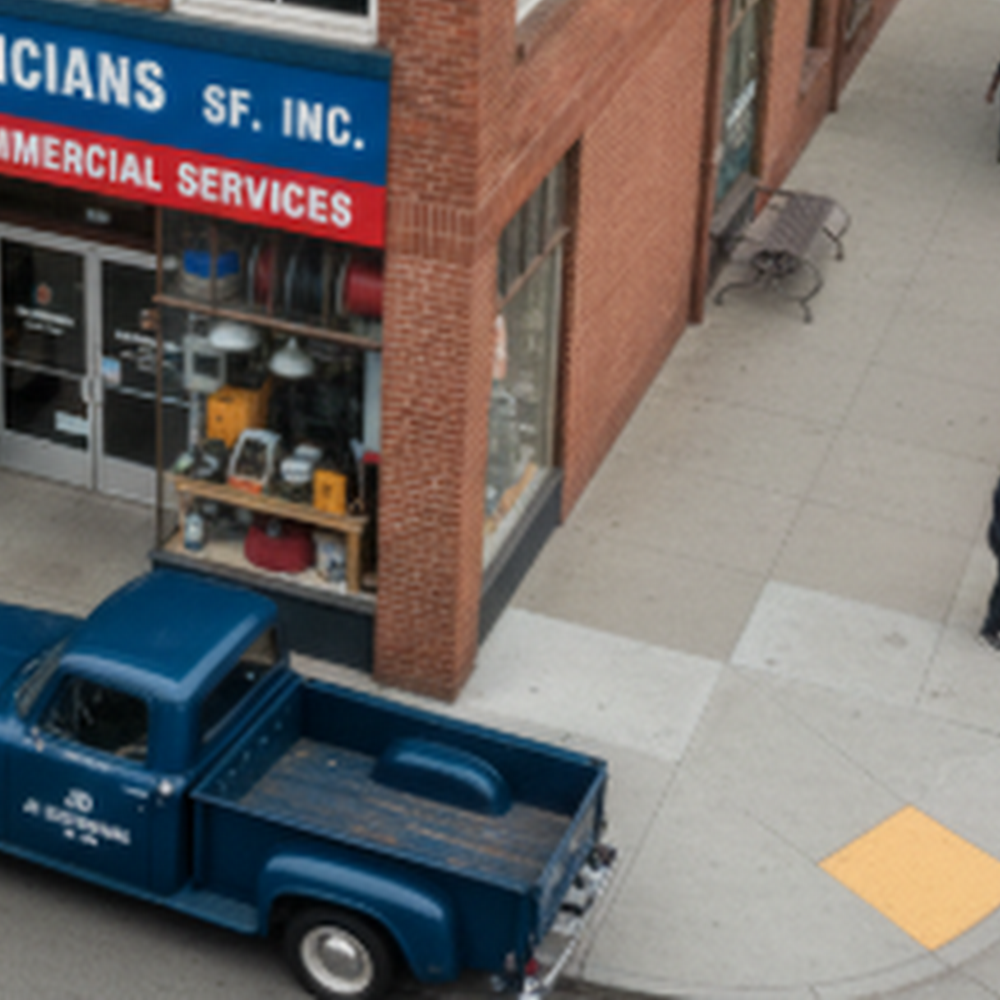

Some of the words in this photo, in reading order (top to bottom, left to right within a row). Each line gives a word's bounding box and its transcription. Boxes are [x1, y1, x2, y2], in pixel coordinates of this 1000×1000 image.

[203, 84, 261, 131] SF.
[283, 98, 364, 150] INC.
[177, 162, 353, 228] SERVICES
